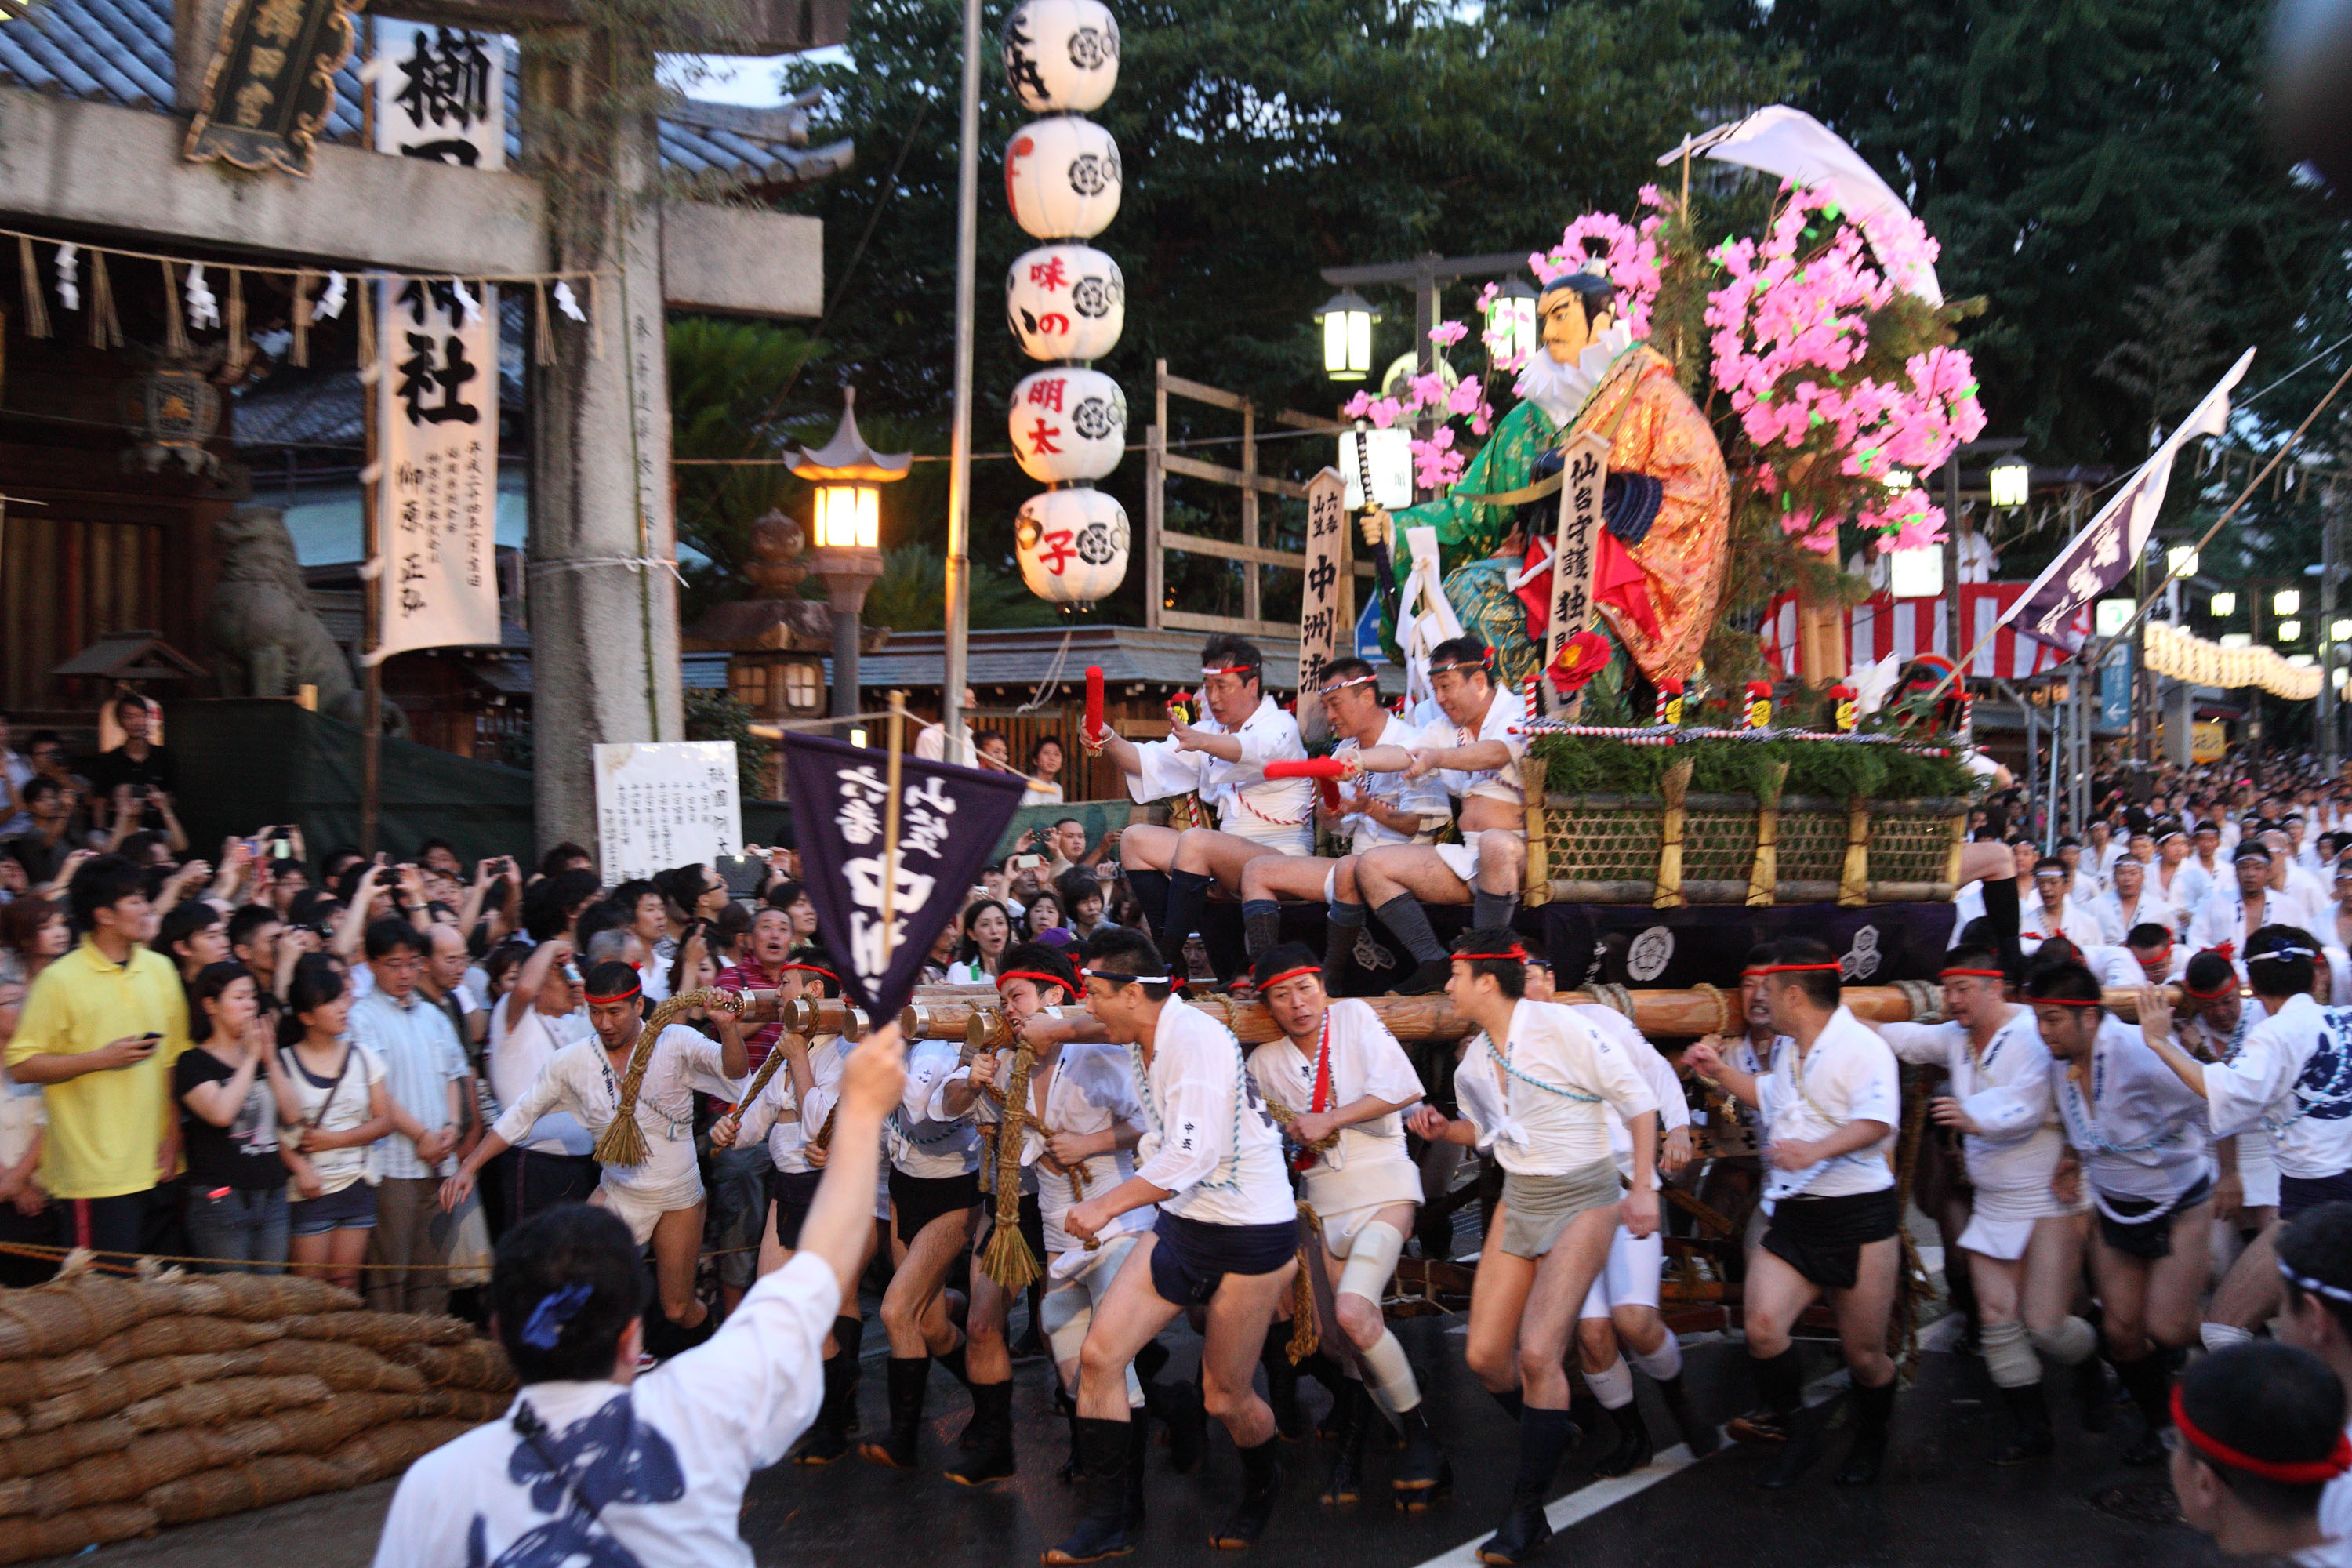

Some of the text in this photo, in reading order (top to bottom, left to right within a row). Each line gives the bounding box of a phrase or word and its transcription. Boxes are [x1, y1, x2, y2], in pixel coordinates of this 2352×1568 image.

[396, 26, 491, 426] 櫛社
[1029, 256, 1069, 336] 味の
[1027, 378, 1067, 456] 明太
[1038, 528, 1078, 577] 子
[1312, 495, 1326, 538] 山笠
[1327, 492, 1339, 534] 六番
[1554, 452, 1599, 705] 仙台守護独
[1300, 554, 1338, 694] 中洲流
